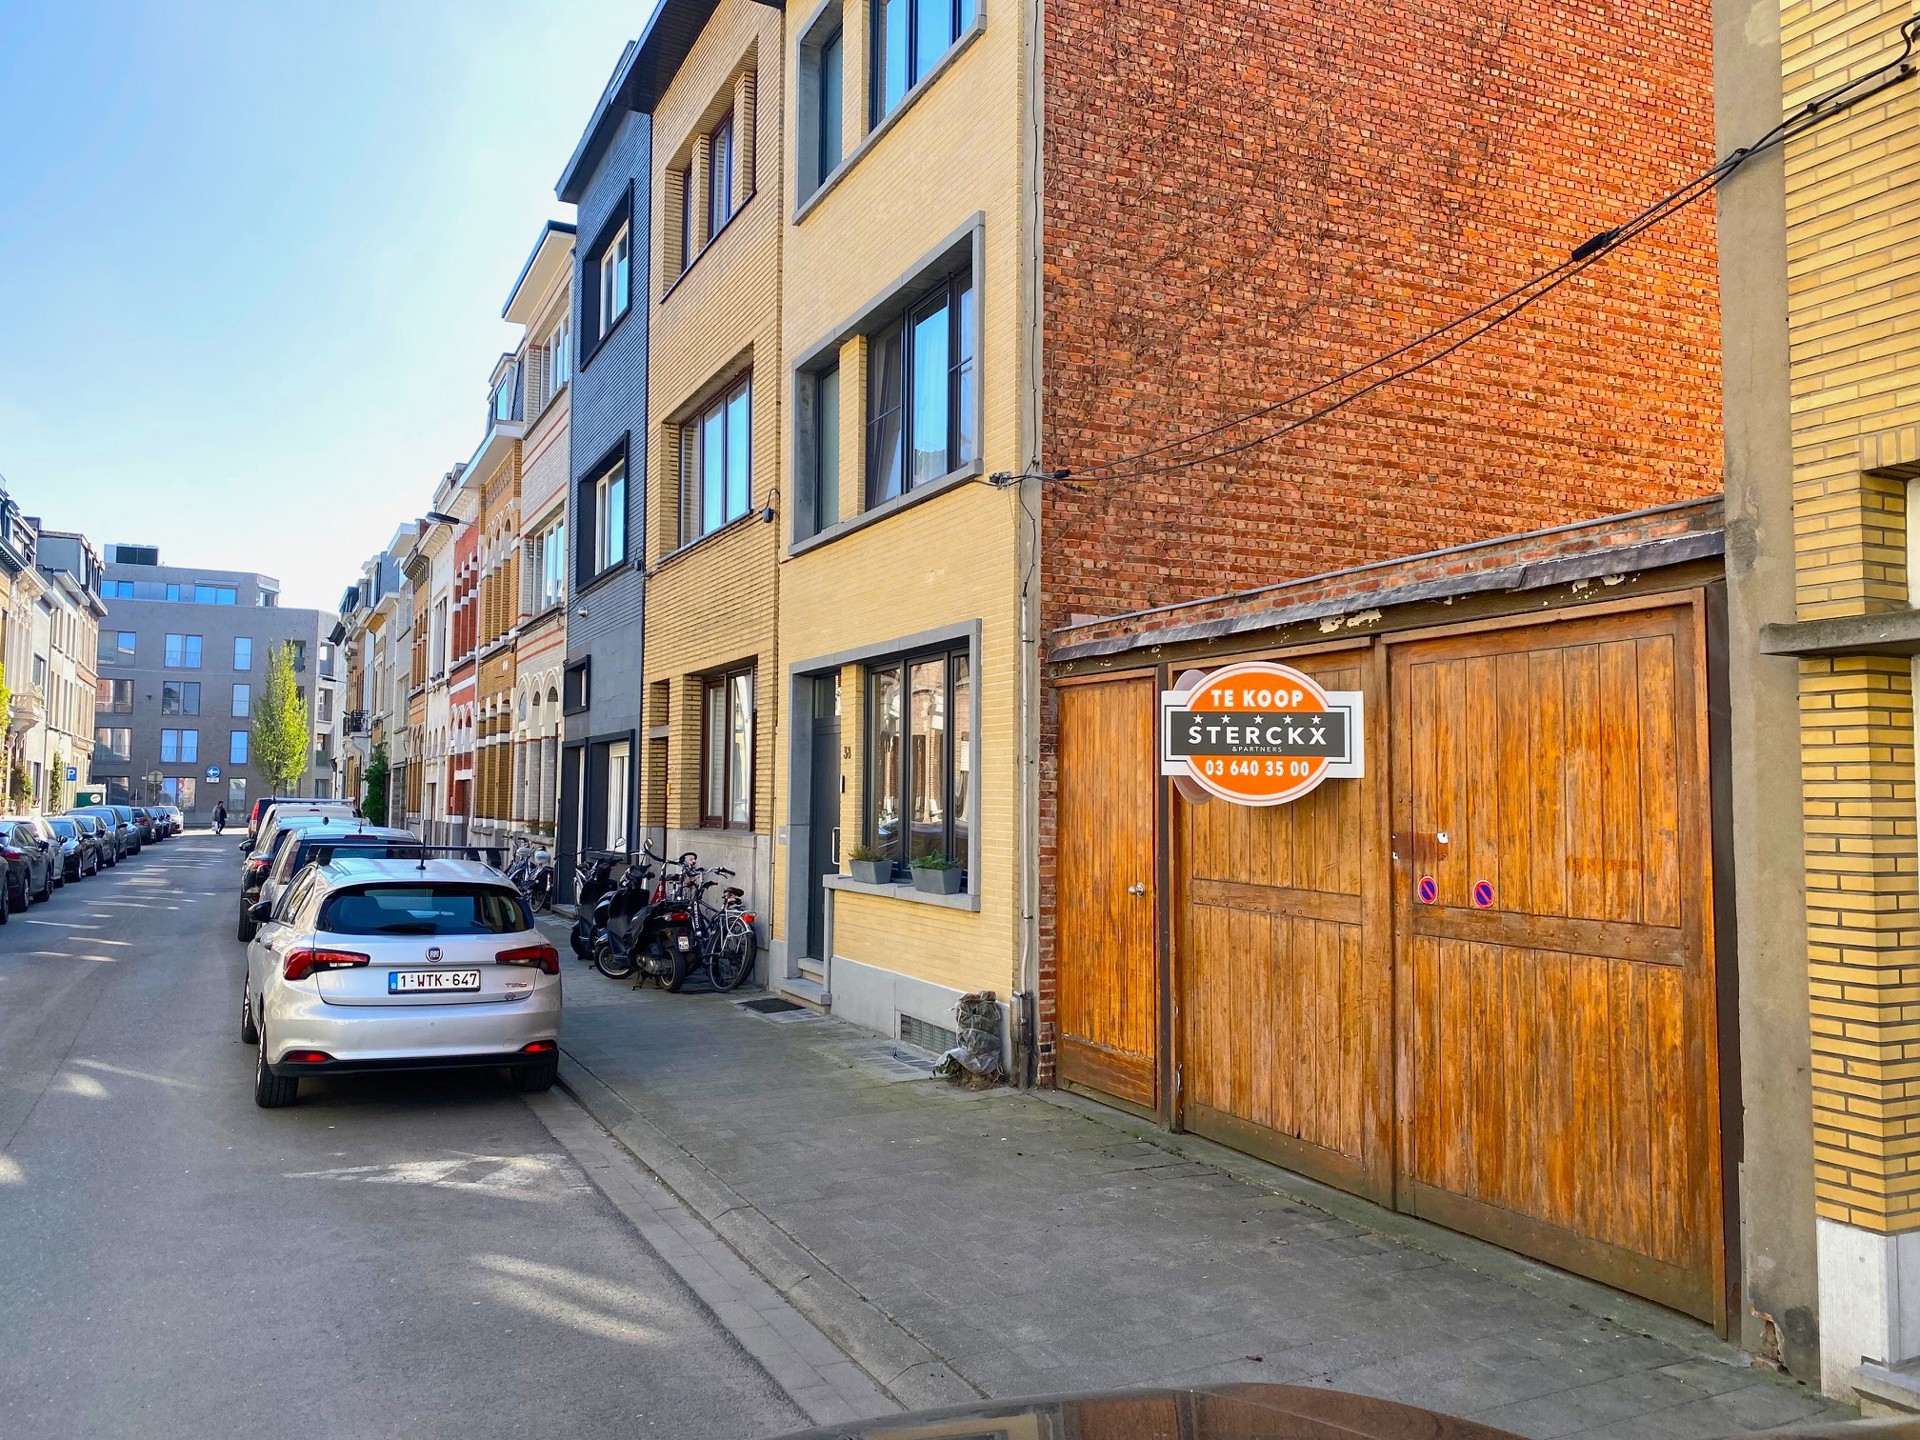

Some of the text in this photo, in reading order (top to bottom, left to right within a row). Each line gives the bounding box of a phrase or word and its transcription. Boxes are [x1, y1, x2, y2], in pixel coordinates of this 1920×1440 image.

[1211, 689, 1303, 707] TE KOOP
[1188, 726, 1327, 745] STERCKX
[67, 769, 76, 779] P
[1205, 760, 1309, 777] 03 640 35 00
